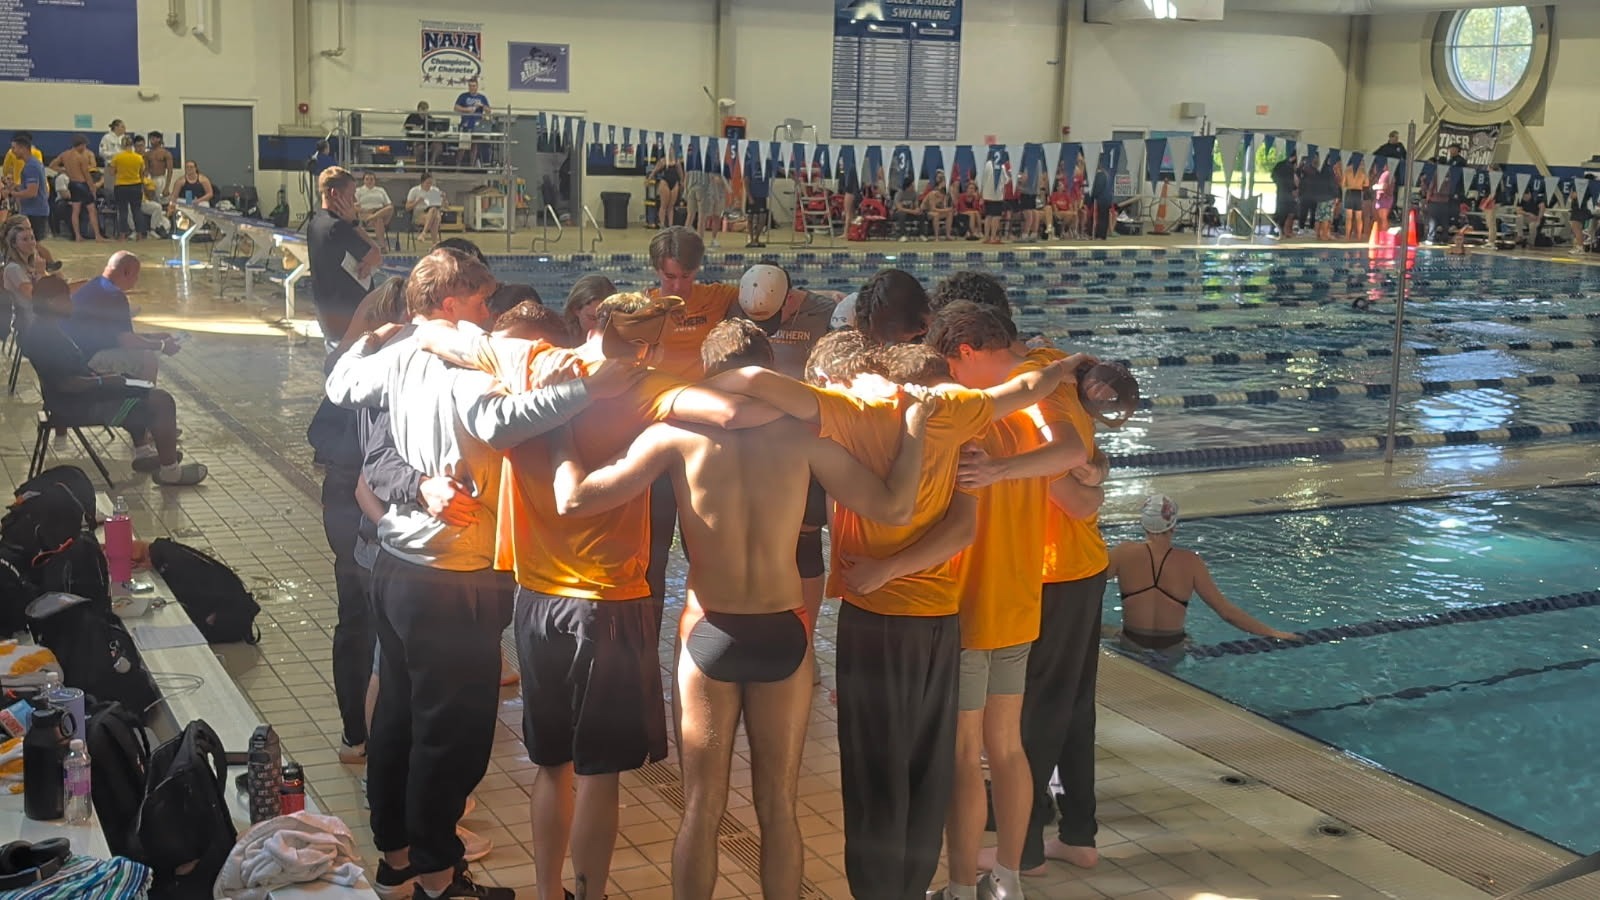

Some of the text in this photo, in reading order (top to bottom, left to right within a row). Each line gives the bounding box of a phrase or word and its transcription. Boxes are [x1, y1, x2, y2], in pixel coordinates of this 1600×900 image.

[891, 8, 951, 20] SWIMMING
[424, 31, 480, 56] NAIA
[428, 66, 474, 74] of Character
[431, 57, 471, 66] Champions
[1439, 133, 1470, 150] TIGER
[898, 152, 905, 169] 3
[993, 151, 1001, 170] 2
[1109, 149, 1114, 169] 1
[1478, 173, 1571, 194] B L U E
